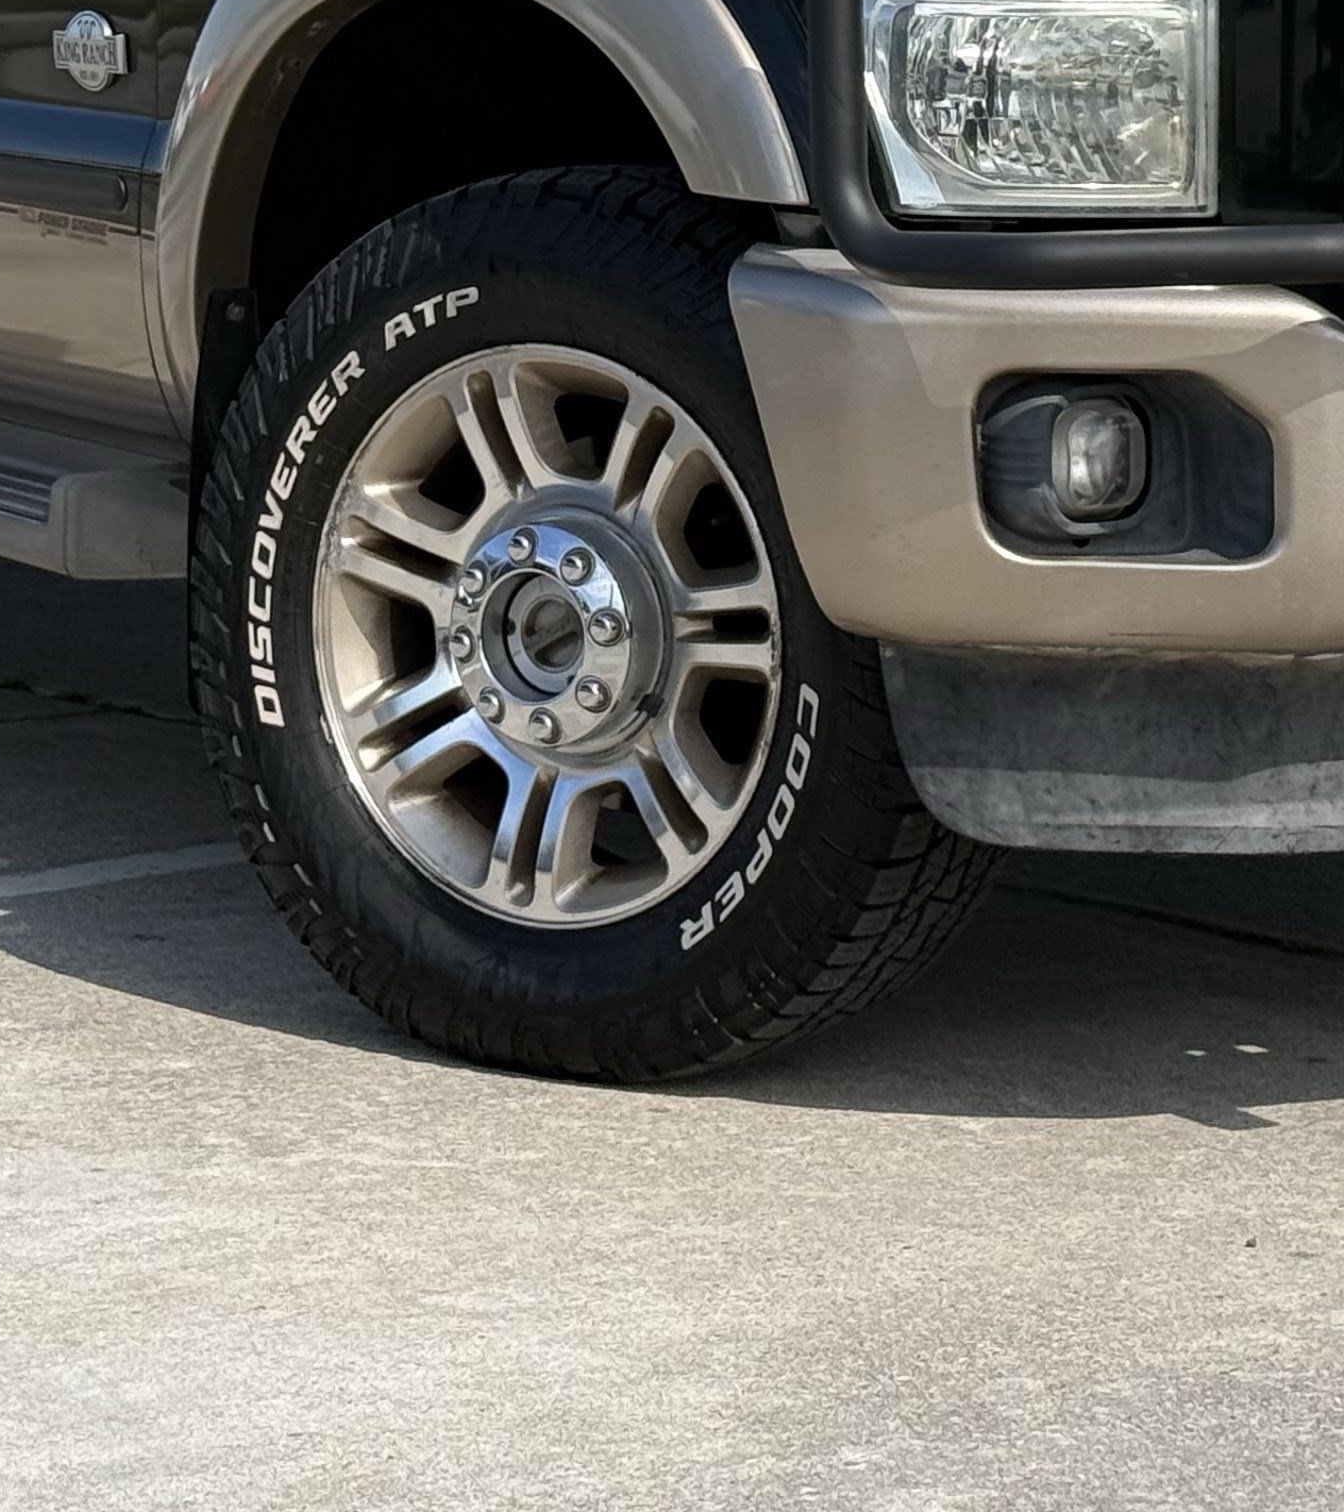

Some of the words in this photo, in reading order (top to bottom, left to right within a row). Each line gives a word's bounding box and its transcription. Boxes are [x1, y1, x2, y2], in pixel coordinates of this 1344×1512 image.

[56, 39, 81, 65] KING
[82, 41, 117, 67] RANCH
[244, 349, 368, 729] DISCOVERER
[381, 284, 480, 355] ATP
[679, 681, 822, 952] COOPER
